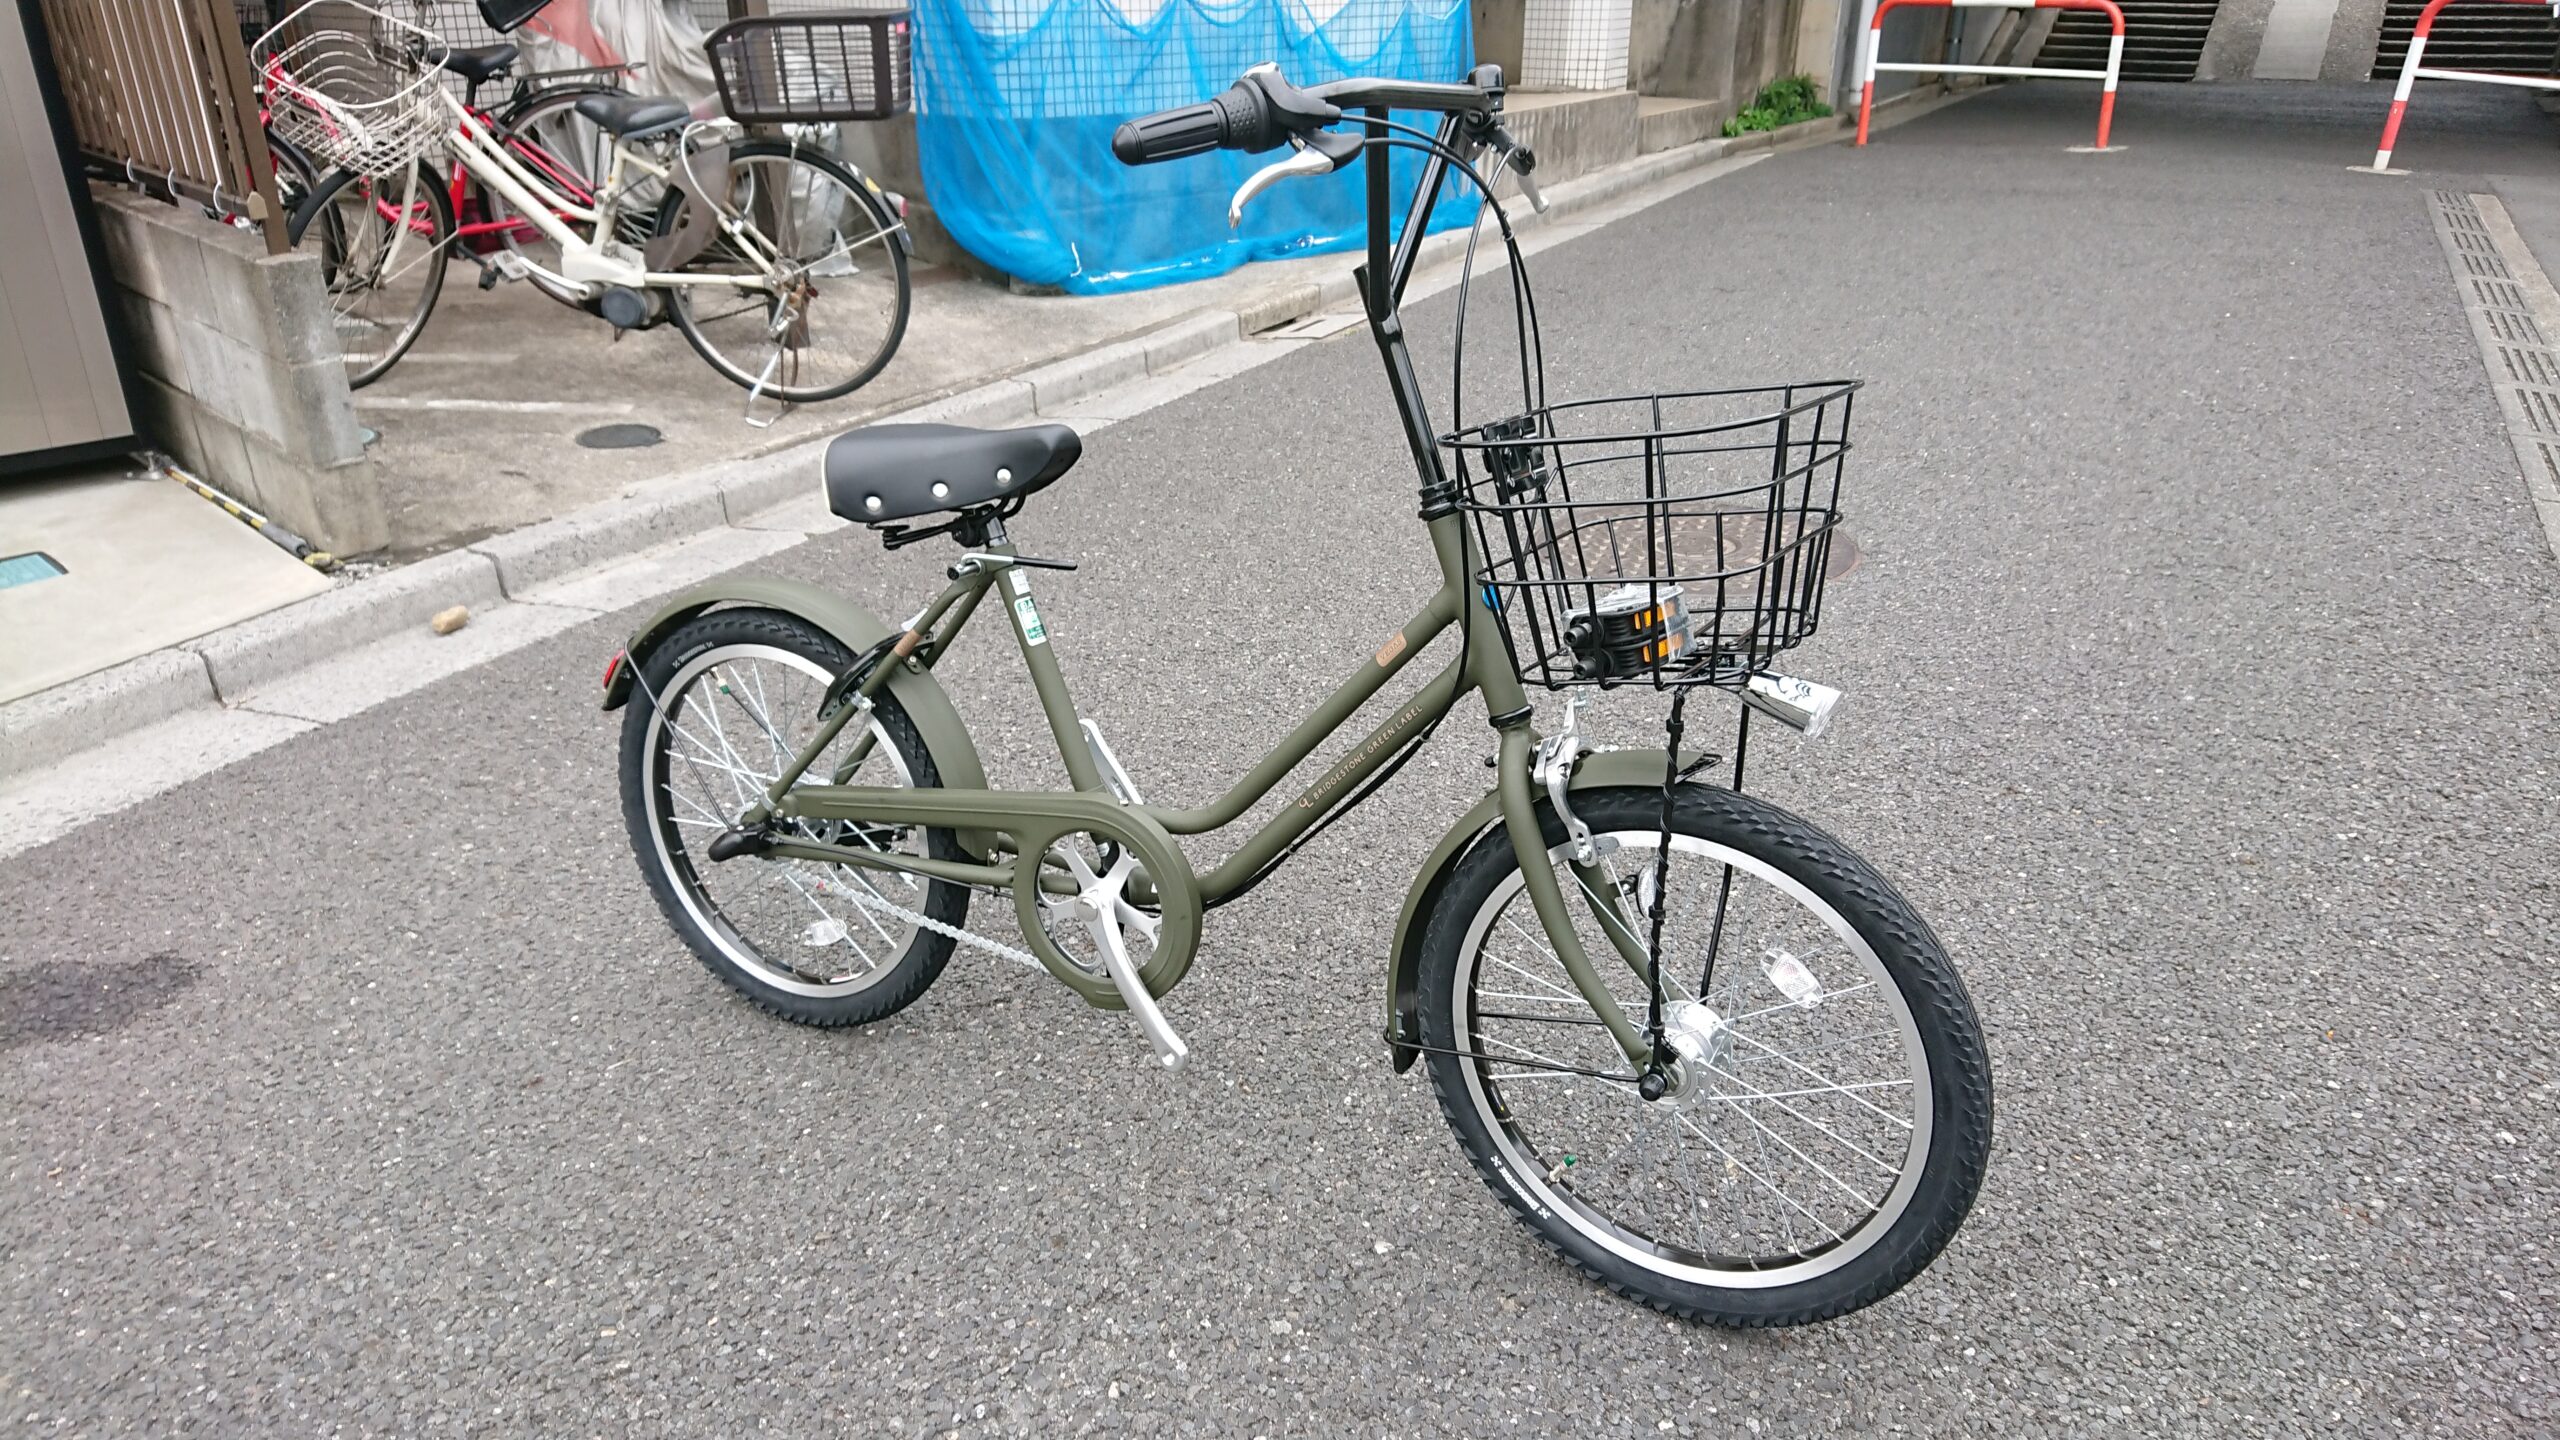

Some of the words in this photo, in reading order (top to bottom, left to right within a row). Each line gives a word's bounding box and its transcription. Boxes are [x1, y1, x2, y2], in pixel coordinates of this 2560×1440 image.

[1312, 751, 1367, 801] BRIDGESTONE
[1366, 727, 1395, 754] GREEN
[1395, 705, 1423, 729] LABEL
